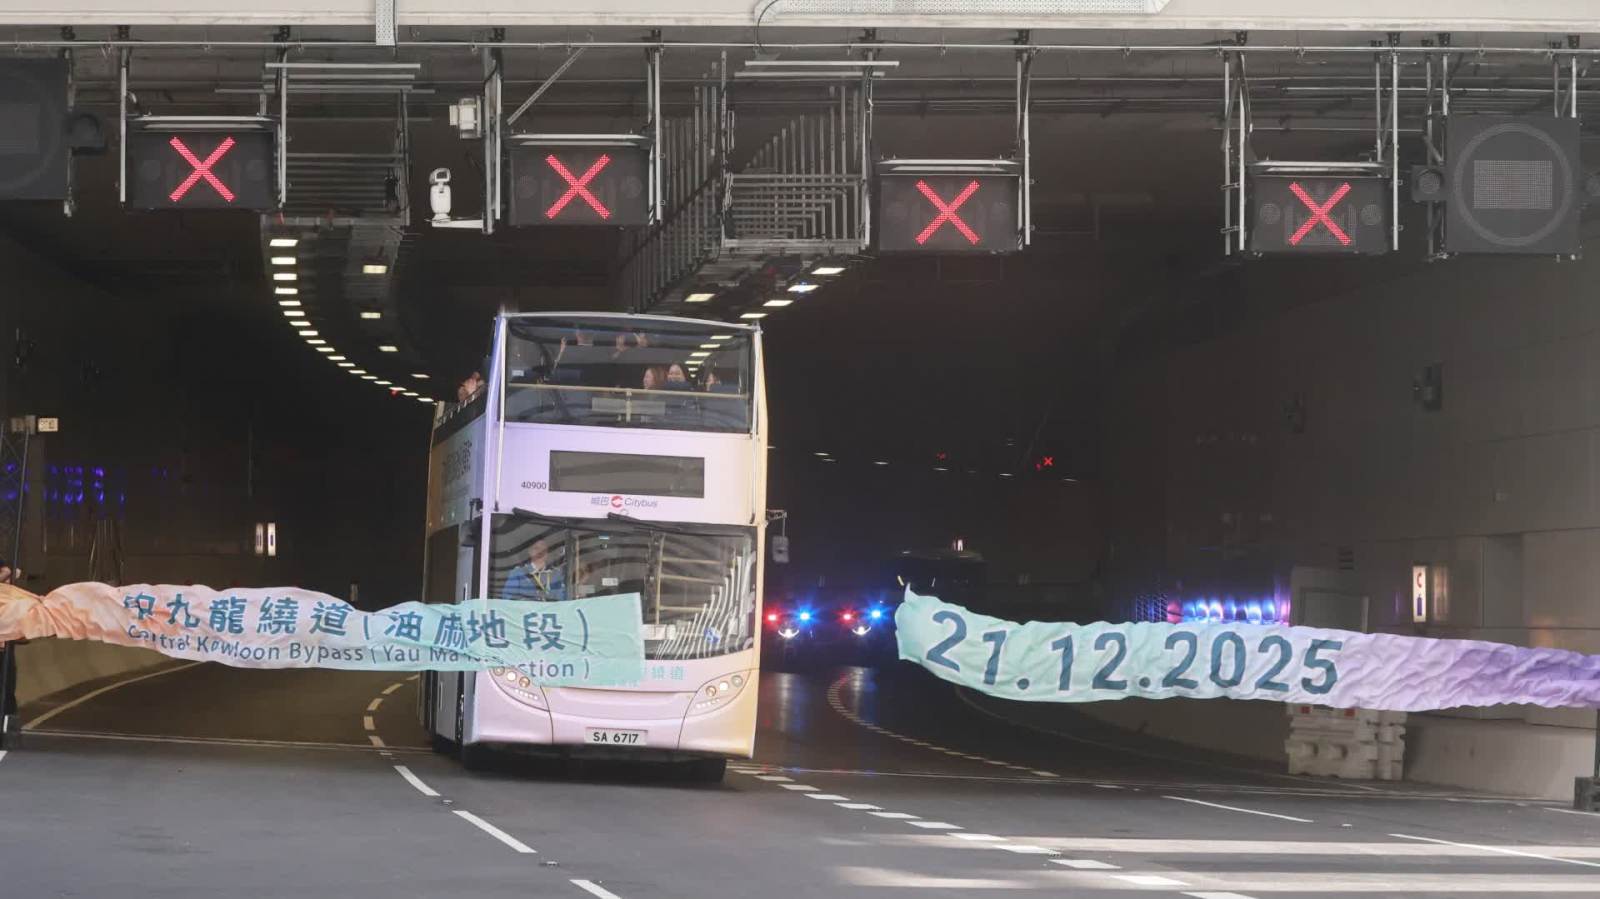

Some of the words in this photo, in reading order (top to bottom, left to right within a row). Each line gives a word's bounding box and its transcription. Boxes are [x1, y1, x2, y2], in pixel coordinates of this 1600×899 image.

[521, 481, 547, 490] 40900
[624, 497, 657, 508] Citybus
[197, 636, 280, 660] Kowloon
[289, 643, 364, 664] Bypass
[430, 646, 459, 662] Ma
[926, 610, 1343, 694] 21.12.2025
[593, 732, 608, 742] SA
[613, 732, 639, 743] 6717
